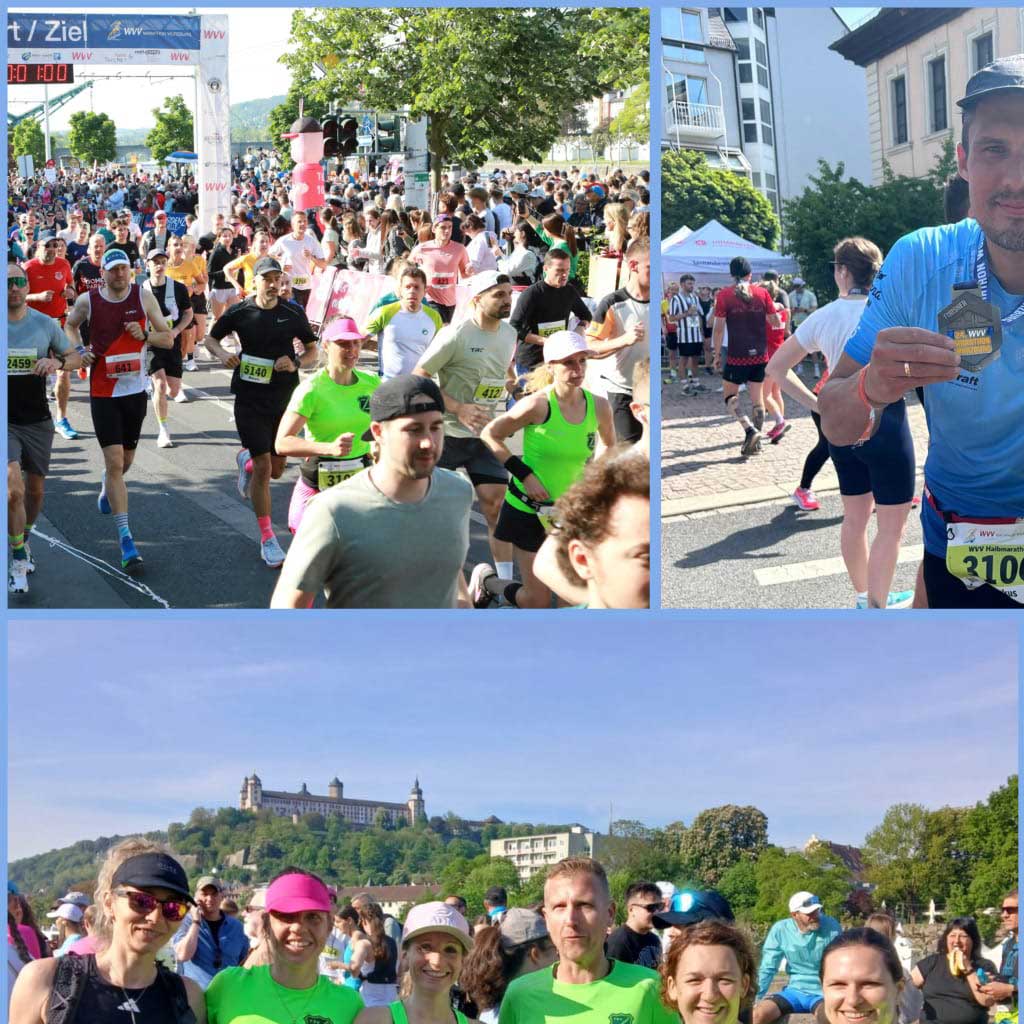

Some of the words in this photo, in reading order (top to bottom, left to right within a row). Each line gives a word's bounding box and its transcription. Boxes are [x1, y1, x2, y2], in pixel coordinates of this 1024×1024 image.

[8, 20, 20, 41] t
[45, 20, 88, 41] Ziel
[123, 27, 142, 36] WVV
[204, 31, 225, 39] WVV
[72, 52, 93, 60] WVV
[170, 53, 190, 61] WVV
[205, 182, 226, 191] WVV
[968, 329, 987, 338] WVV
[244, 365, 267, 377] 5140
